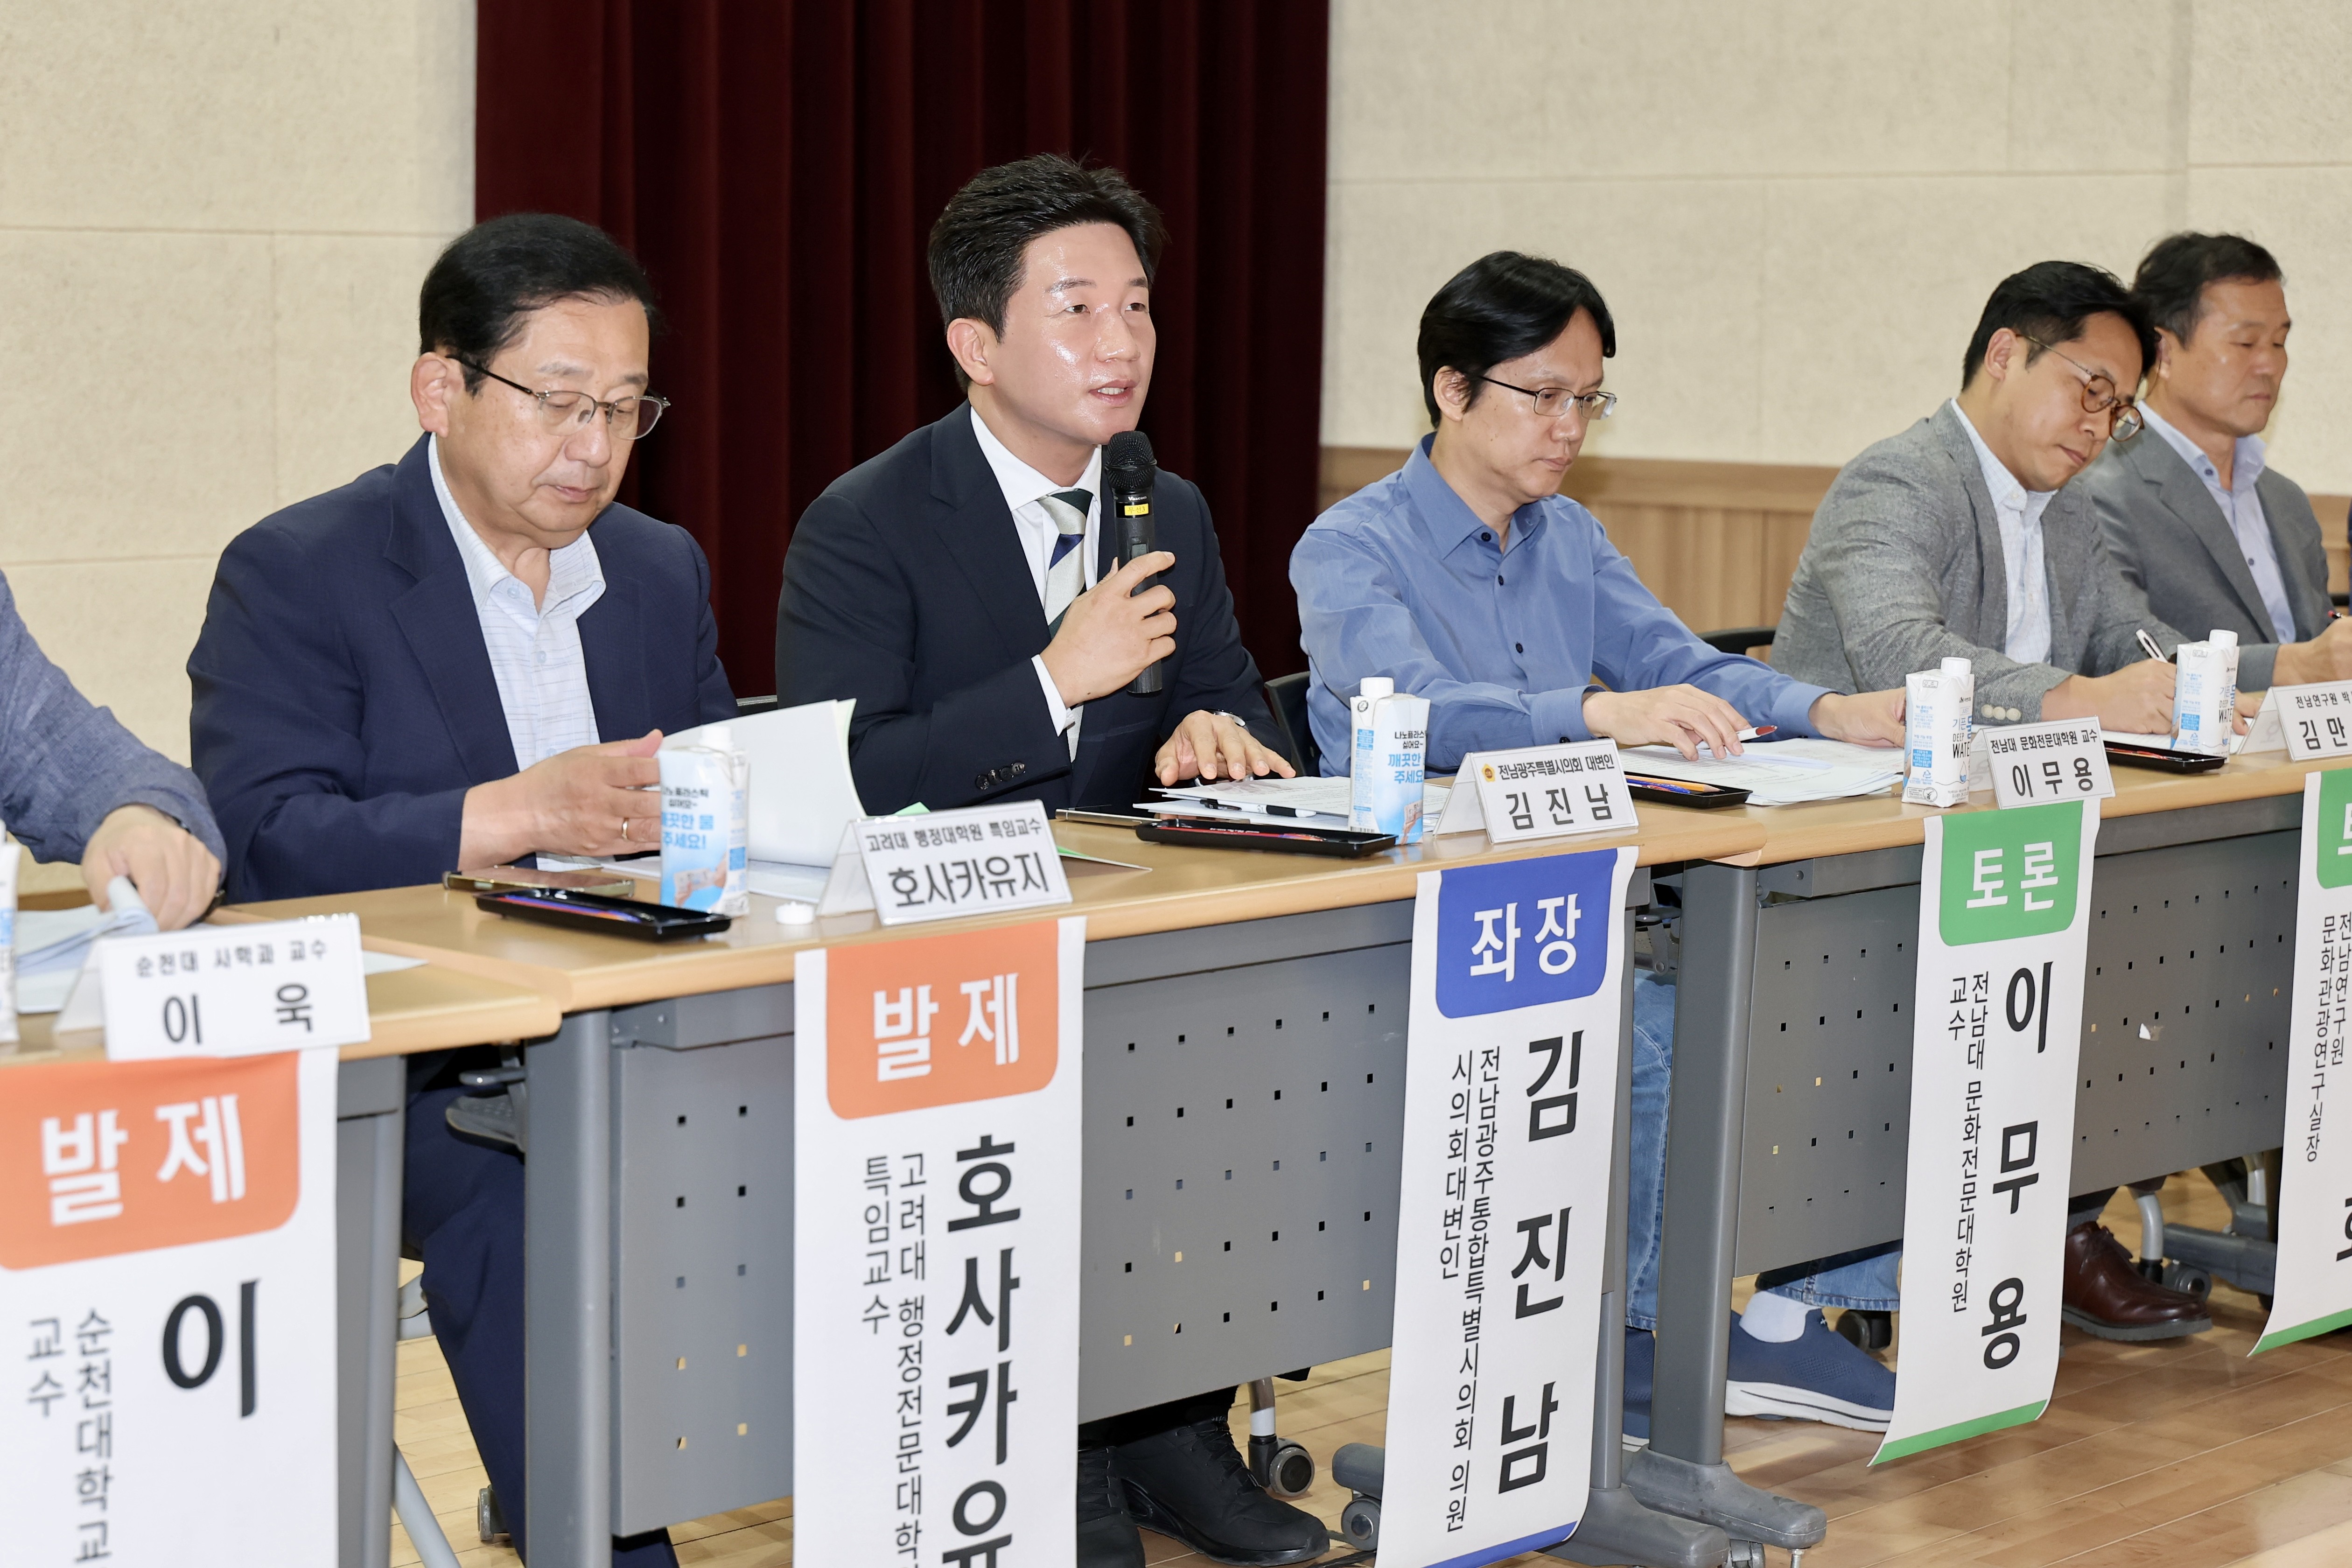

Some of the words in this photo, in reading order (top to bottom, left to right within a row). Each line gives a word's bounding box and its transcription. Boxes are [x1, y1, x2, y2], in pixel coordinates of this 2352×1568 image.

[1953, 733, 1964, 742] DEEP
[2219, 708, 2232, 723] WATE
[2296, 693, 2338, 708] 전남연구원
[2342, 690, 2352, 704] 박
[2299, 717, 2348, 750] 김만
[1388, 753, 1421, 767] 깨끗한
[1394, 770, 1423, 784] 주세요
[1498, 757, 1583, 780] 전남광주특별시의회
[1585, 754, 1615, 771] 대변인
[1953, 742, 1970, 759] WATE
[1990, 738, 2017, 754] 전남대
[2020, 730, 2078, 750] 문화전문대학원
[2081, 729, 2098, 743] 교수
[866, 831, 909, 852] 고려대
[914, 823, 983, 848] 행정대학원
[989, 817, 1042, 838] 특임교수
[888, 852, 1049, 907] 호사카유지
[1966, 841, 2058, 911] 토론
[135, 950, 198, 978] 순천대
[213, 943, 274, 967] 사학과
[288, 938, 327, 961] 교수
[1470, 893, 1581, 982] 좌장
[873, 973, 1020, 1083] 발제
[1948, 977, 1966, 1041] 교수
[1967, 971, 1989, 1070] 전남대
[2331, 911, 2352, 1066] 전남연구원
[2306, 915, 2336, 1162] 문화관광연구실장
[41, 1093, 246, 1227] 발제
[1440, 1050, 1472, 1280] 시의회대변인
[1951, 1080, 1982, 1313] 문화전문대학원
[862, 1155, 892, 1335] 특임교수
[899, 1152, 928, 1281] 고려대
[1453, 1046, 1500, 1450] 전남광주통합특별시의회
[26, 1316, 67, 1419] 교수
[161, 1278, 262, 1419] 이
[73, 1307, 115, 1563] 순천대학교
[894, 1294, 927, 1568] 행정전문대학
[1446, 1459, 1470, 1533] 의원
